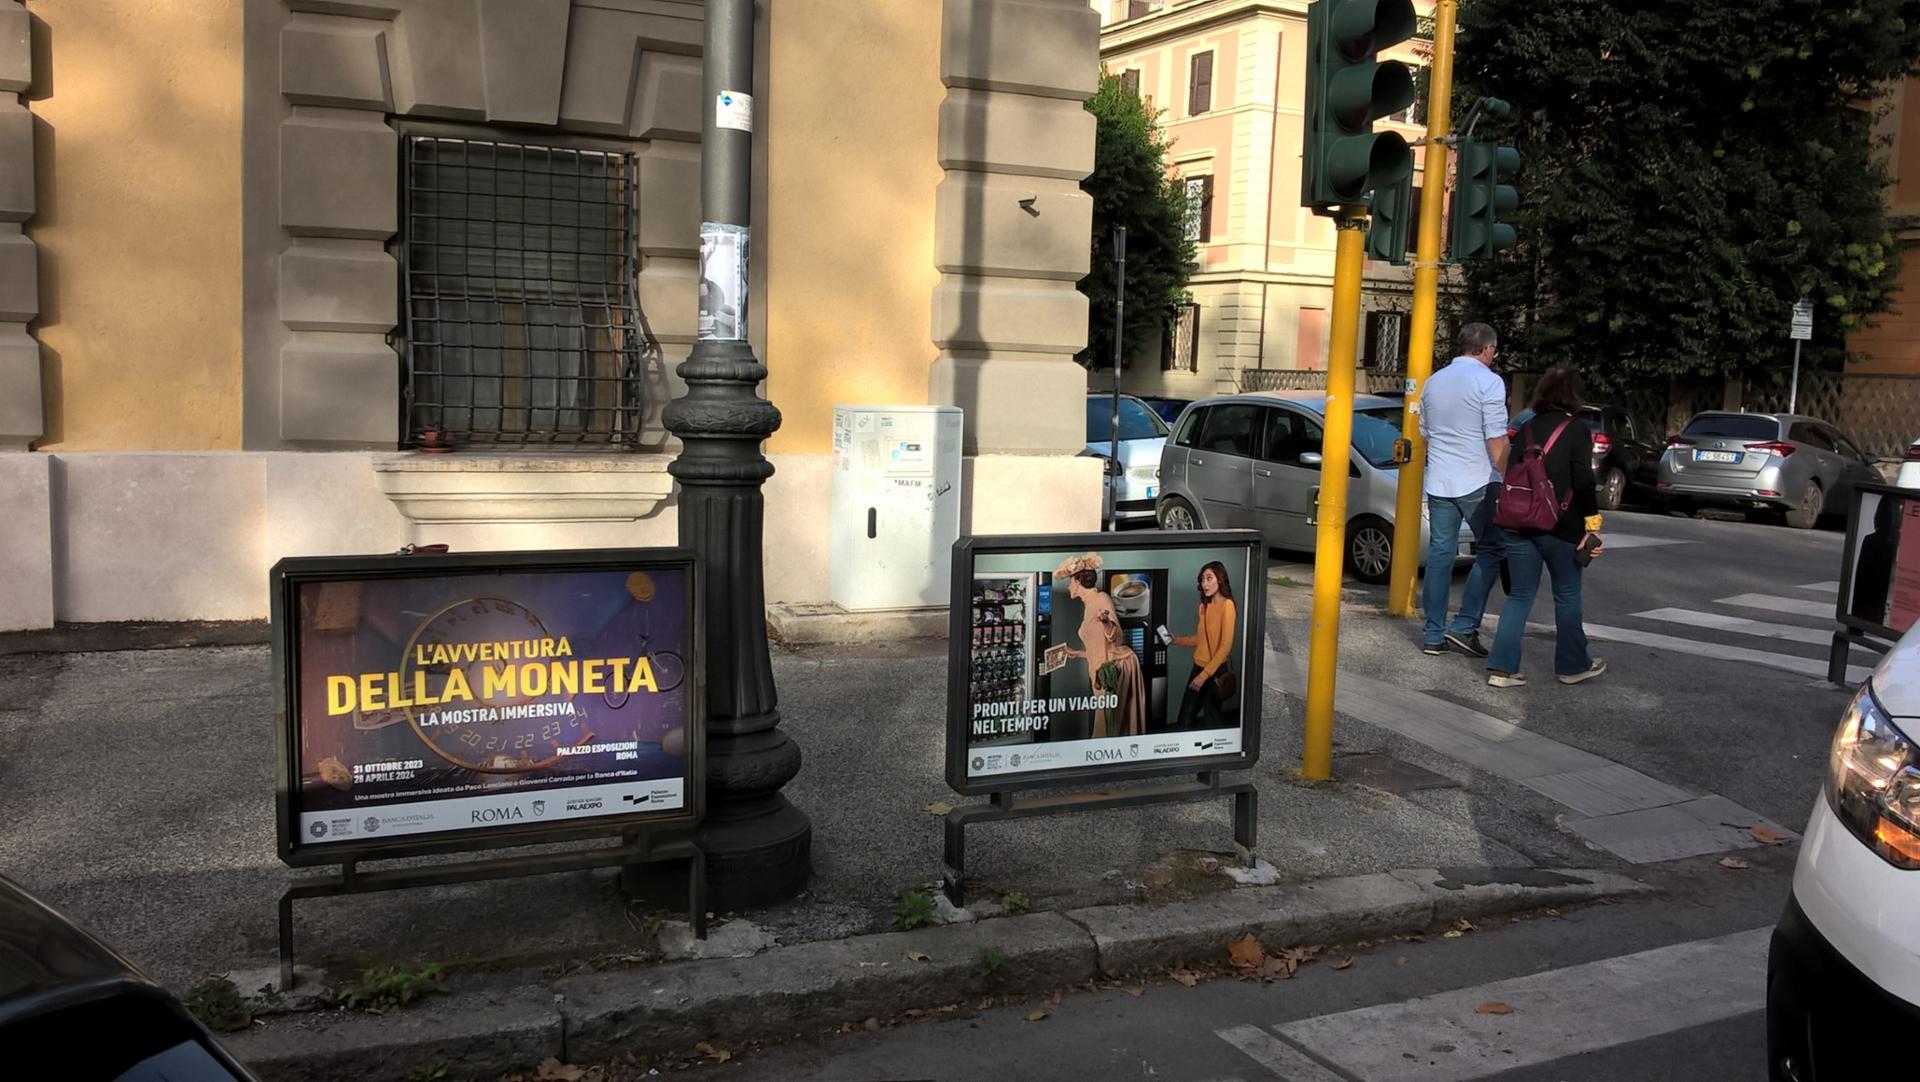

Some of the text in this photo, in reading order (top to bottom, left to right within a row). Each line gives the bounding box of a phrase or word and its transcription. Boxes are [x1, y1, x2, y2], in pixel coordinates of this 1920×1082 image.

[416, 636, 573, 666] L'AVVENTURA
[327, 656, 659, 717] DELLA MONETA
[420, 712, 440, 727] LA
[441, 707, 499, 725] MOSTRA
[501, 702, 577, 720] IMMERSIVA
[973, 694, 1119, 718] PRONTI PER UN VIAGGIO
[514, 733, 535, 748] 22
[542, 721, 561, 740] 23
[972, 715, 1050, 735] NEL TEMPO?
[557, 741, 638, 757] PALAZZO ESPOSIZIONI
[616, 751, 638, 761] ROMA
[1085, 748, 1124, 762] ROMA
[353, 759, 424, 774] 31 OTTOBRE 2023
[353, 770, 415, 784] 28 APRILE 2024
[369, 791, 395, 800] mostra
[395, 788, 432, 797] immersiva
[432, 785, 455, 794] ideata
[594, 770, 615, 779] Banca
[615, 768, 638, 777] d'Italia
[471, 805, 523, 824] ROMA
